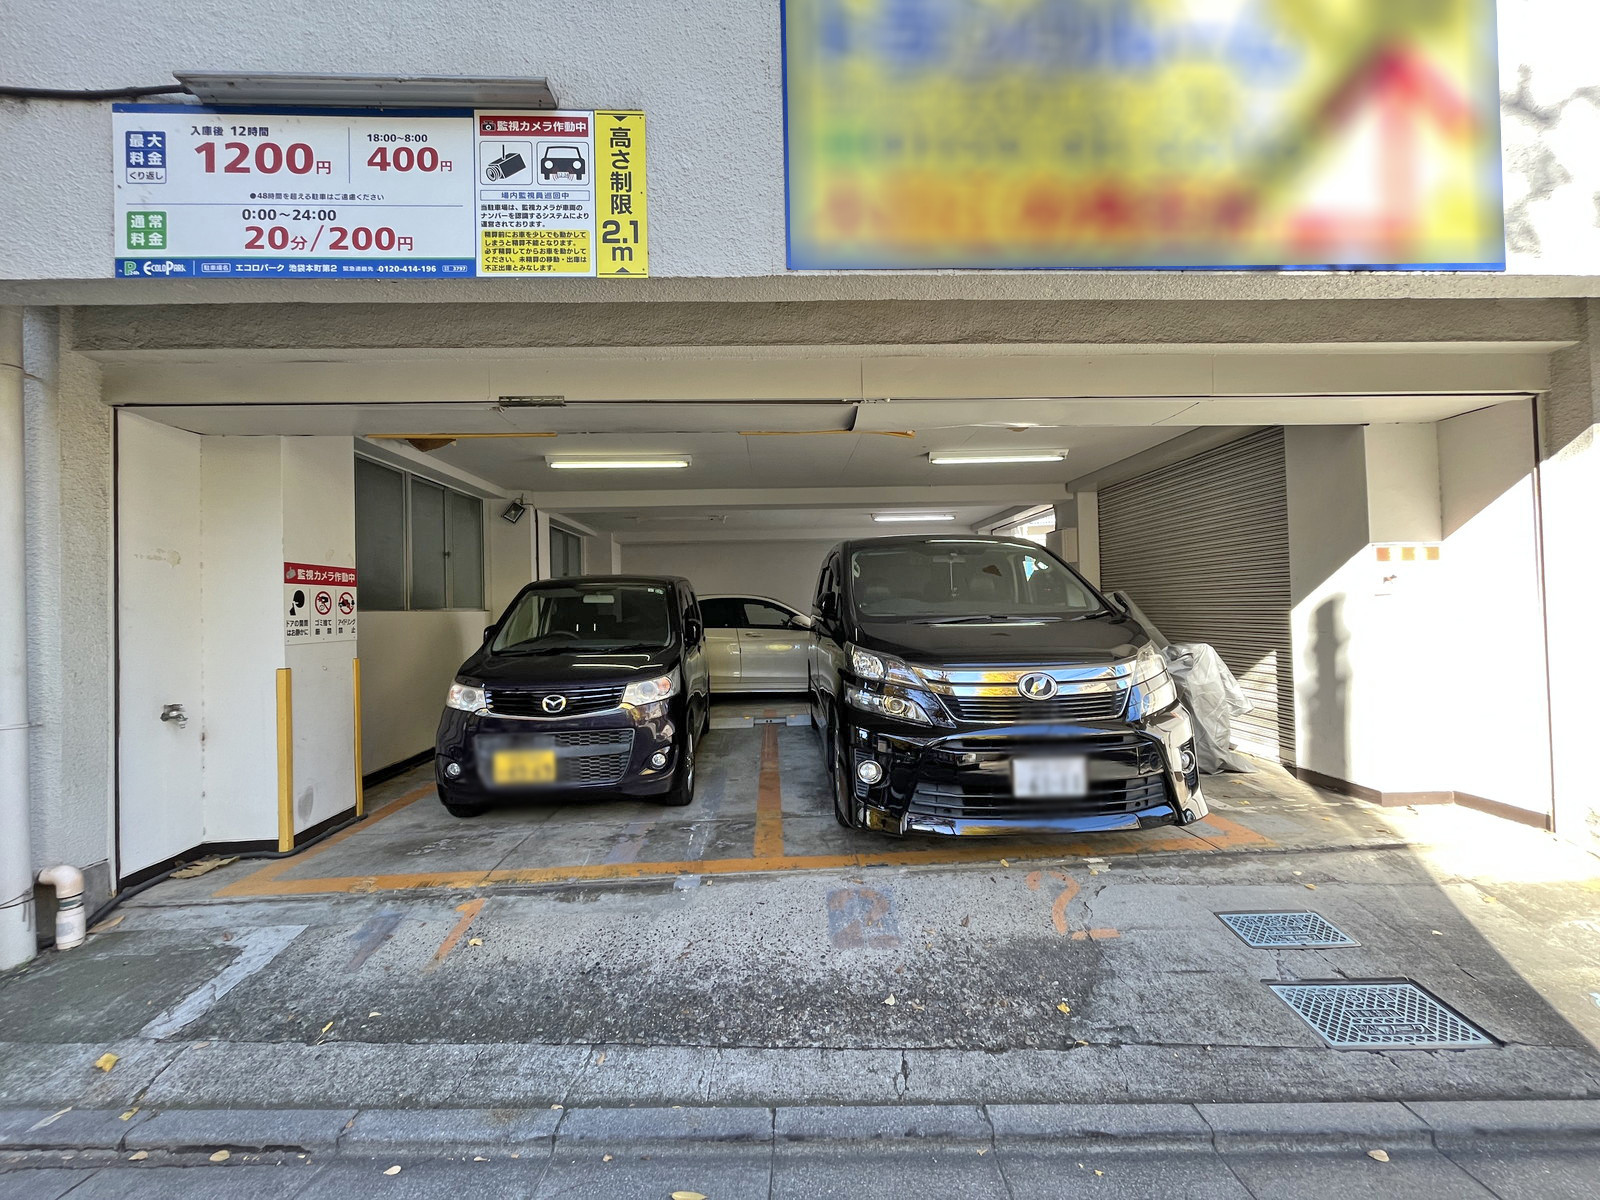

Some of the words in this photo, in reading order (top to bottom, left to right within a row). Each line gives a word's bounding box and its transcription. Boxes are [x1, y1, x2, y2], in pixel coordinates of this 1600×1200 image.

[190, 126, 224, 137] 入庫後
[230, 126, 269, 137] 12時間
[496, 120, 587, 133] 監視カメラ作動中
[129, 134, 163, 148] 最大
[129, 151, 163, 166] 料金
[194, 142, 332, 175] 1200円
[367, 146, 453, 173] 400円
[129, 171, 164, 181] くり返し
[609, 127, 633, 215] 高さ制限
[501, 192, 570, 200] 場内監視員巡回中
[130, 215, 163, 229] 通常
[480, 212, 590, 220] ナンバーを認識するシステムにより
[130, 232, 163, 246] 料金
[244, 225, 414, 252] 20分/200円
[484, 231, 587, 239] 精算前にお車を少しでも動かして
[602, 220, 639, 244] 2.1
[611, 246, 633, 262] m
[235, 263, 285, 272] エコロパーク
[288, 263, 338, 273] 池袋本町第2
[378, 265, 437, 273] 0120-414-196
[297, 568, 356, 583] 監視カメラ作動中
